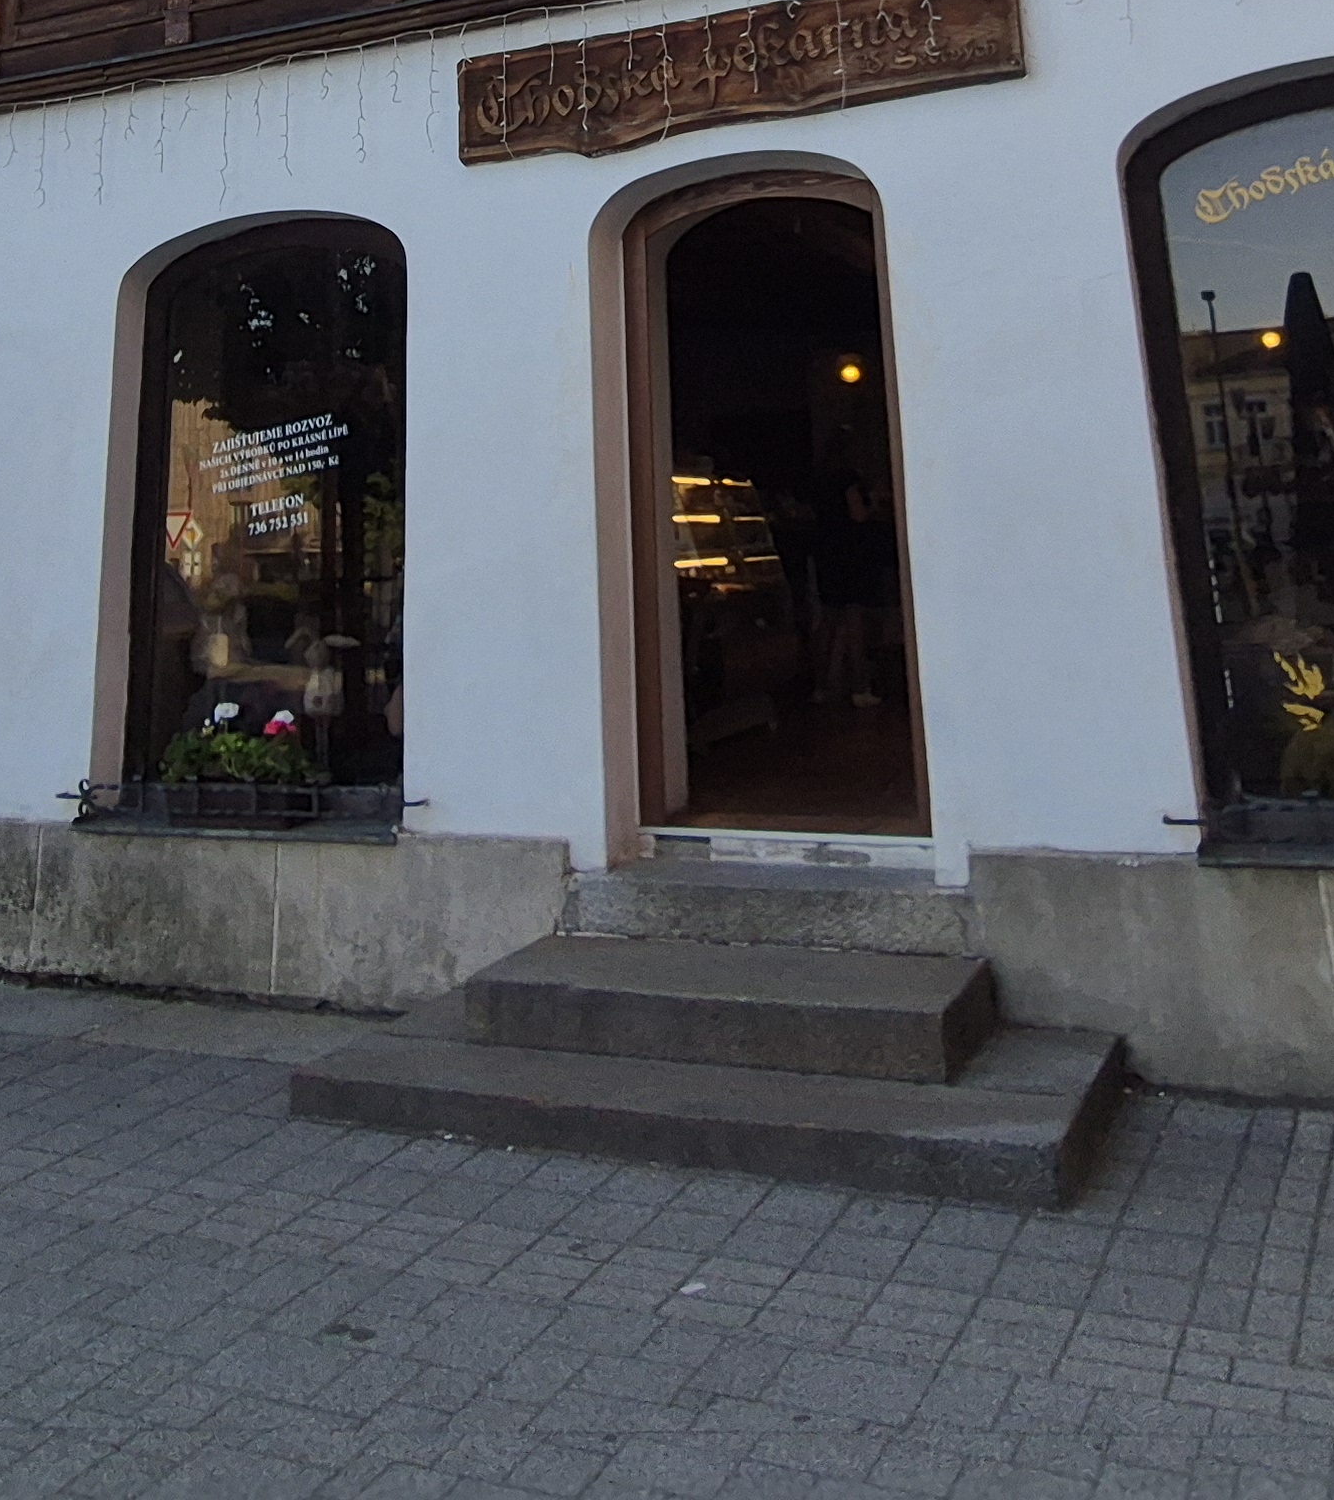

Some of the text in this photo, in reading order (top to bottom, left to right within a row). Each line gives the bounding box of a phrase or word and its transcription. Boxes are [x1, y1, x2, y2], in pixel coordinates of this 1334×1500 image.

[477, 7, 921, 136] Chodská pekárna
[212, 414, 333, 454] ZAJIŠŤUJEME ROZVOZ
[199, 454, 233, 471] NAŠICH
[233, 440, 276, 463] VÝROBKŮ
[278, 440, 291, 452] PO
[285, 453, 294, 463] ve
[295, 449, 305, 461] 14
[285, 463, 306, 477] NAD
[250, 492, 305, 517] TELEFON
